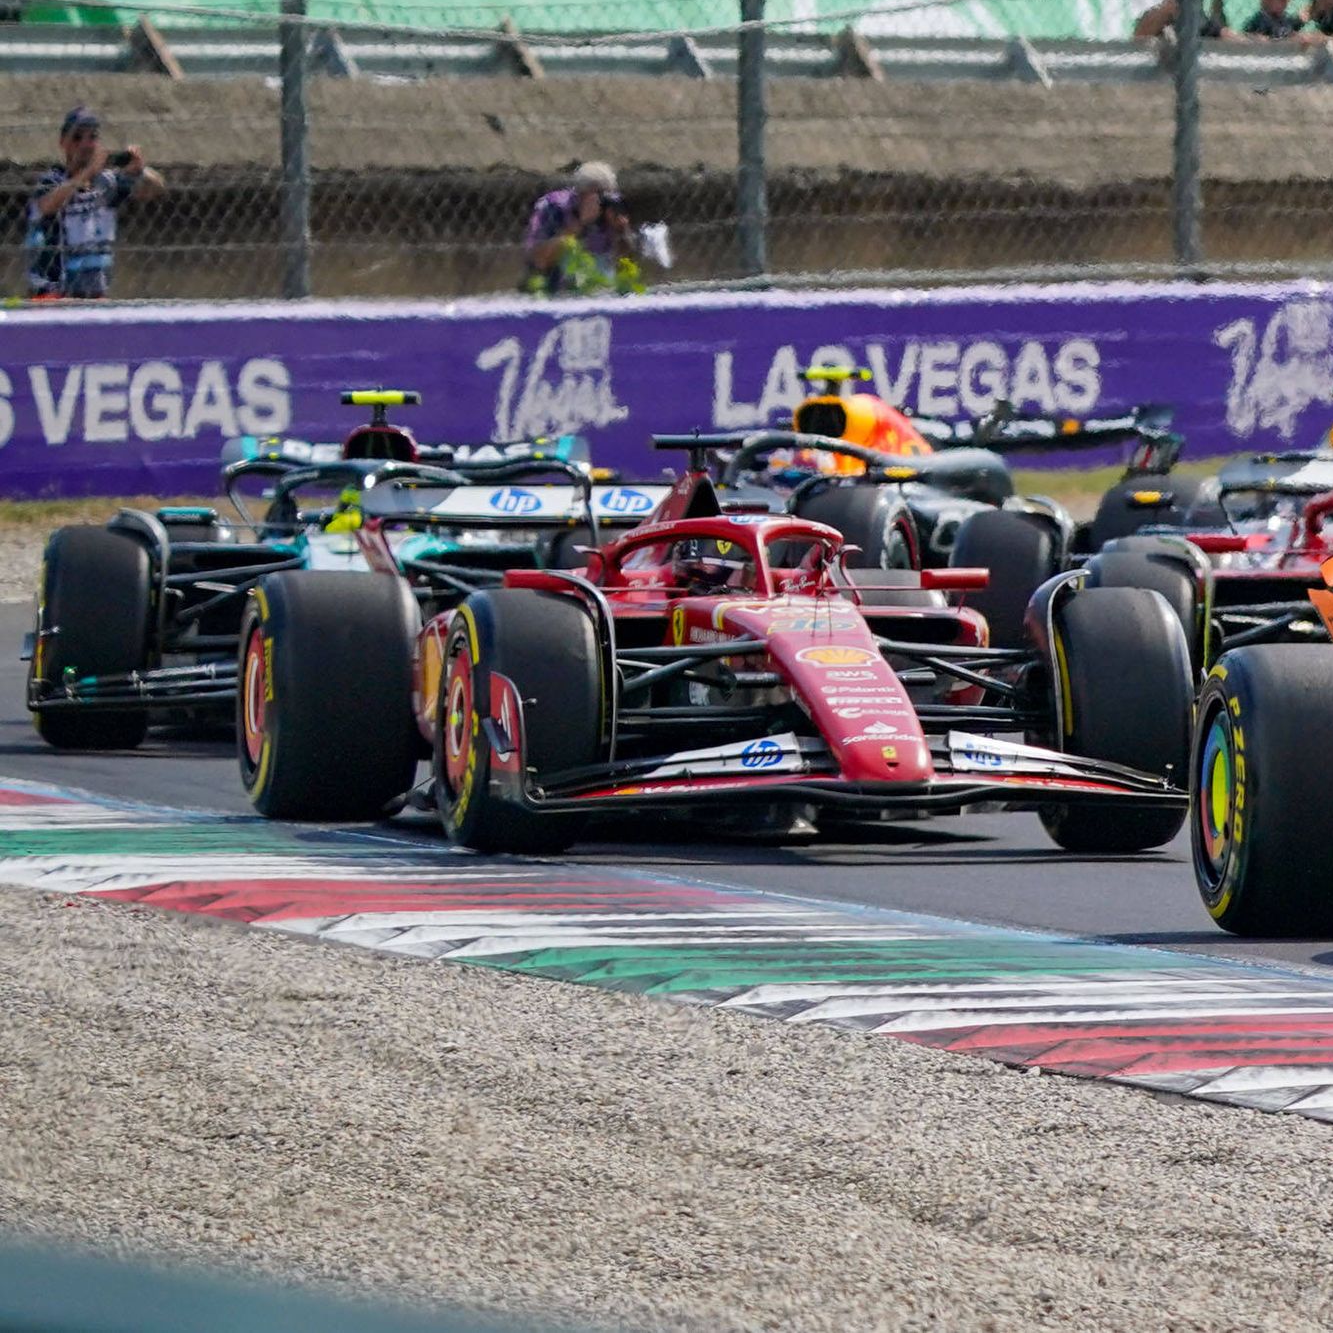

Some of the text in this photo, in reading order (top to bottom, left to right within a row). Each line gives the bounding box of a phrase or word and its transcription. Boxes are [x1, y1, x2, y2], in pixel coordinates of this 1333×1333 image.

[28, 356, 292, 445] VEGAS
[866, 338, 1100, 417] VEGAS
[496, 488, 540, 514] hp
[604, 488, 650, 514] hp
[1233, 726, 1246, 844] ZERO
